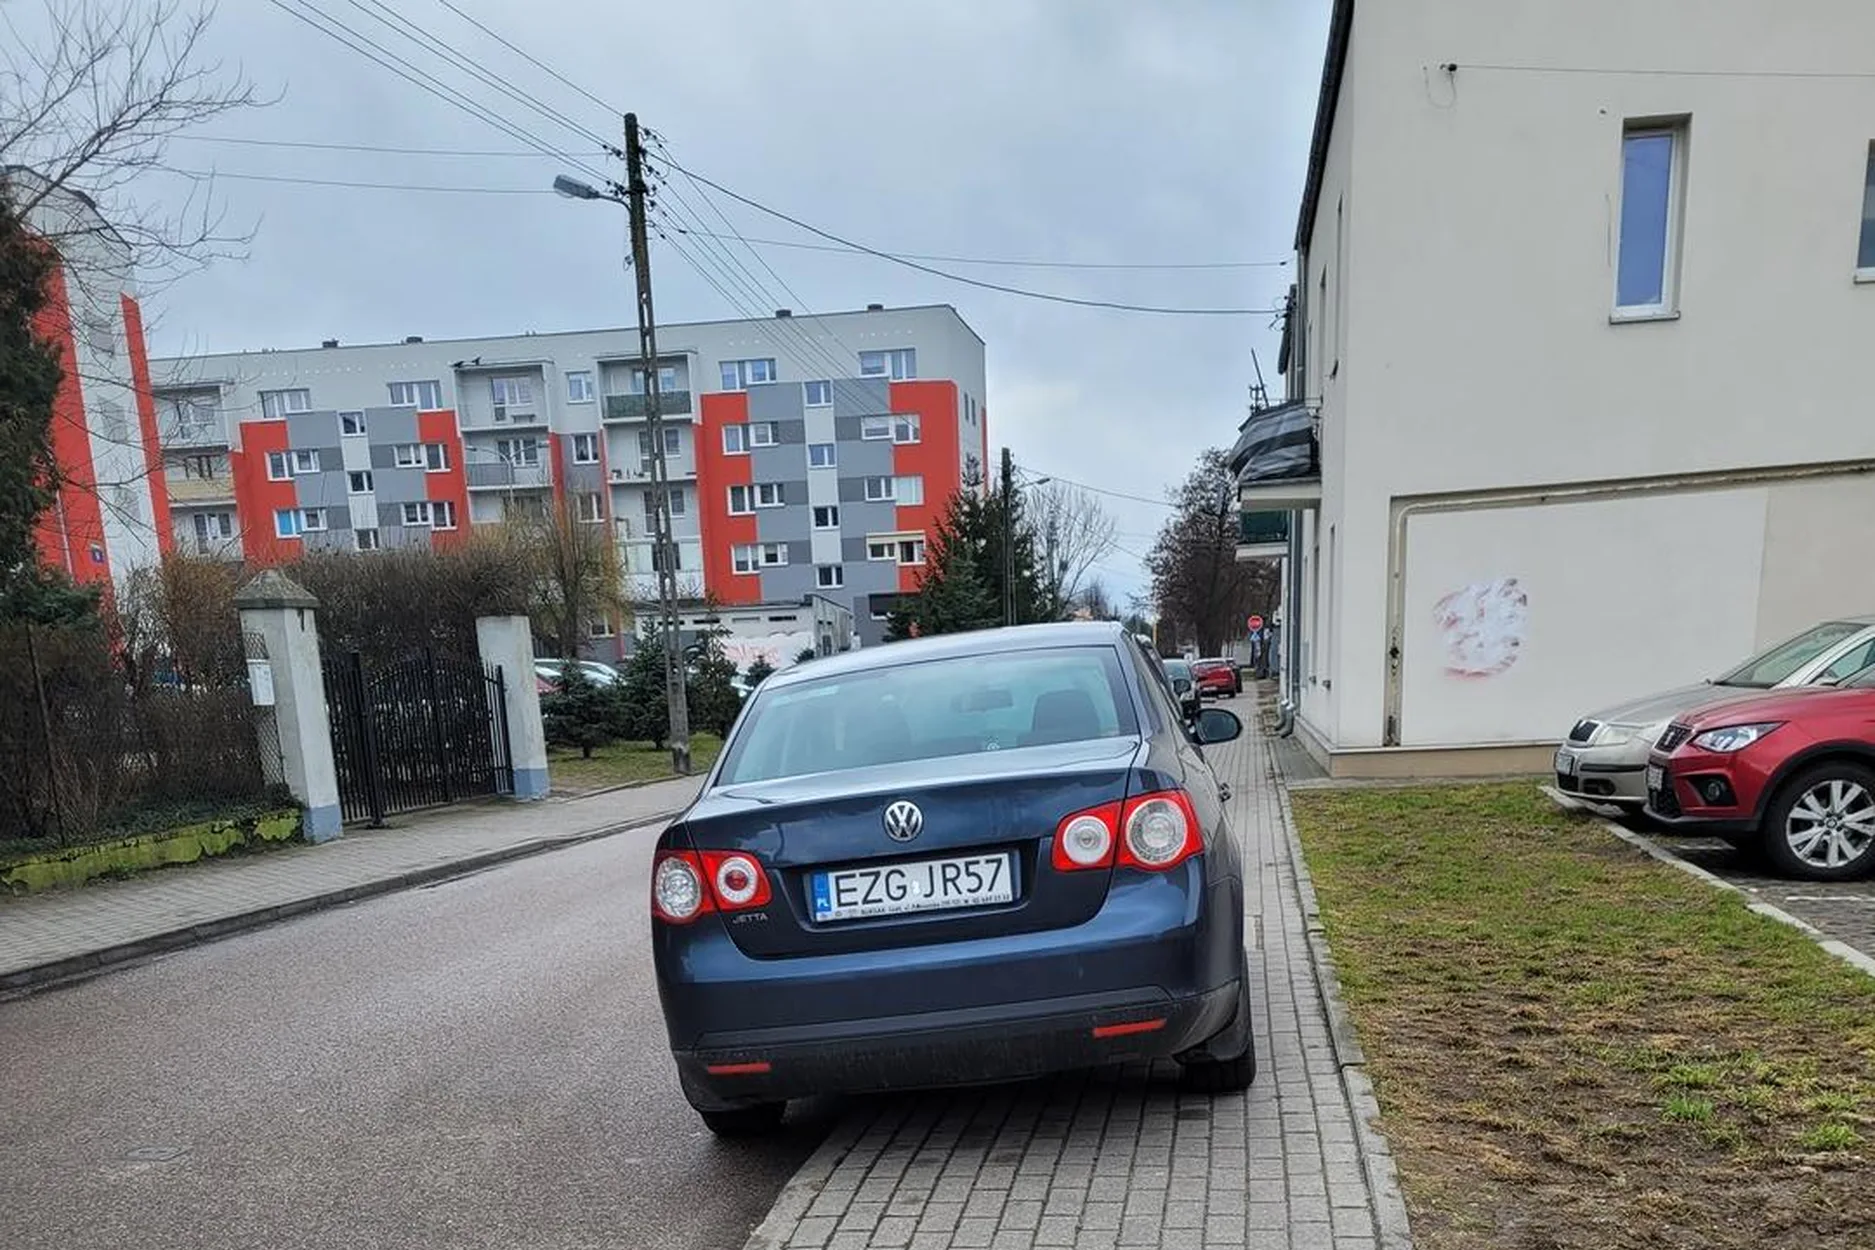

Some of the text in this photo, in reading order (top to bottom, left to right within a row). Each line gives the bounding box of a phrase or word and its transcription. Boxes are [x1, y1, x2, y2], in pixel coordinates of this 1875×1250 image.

[835, 869, 907, 908] EZG
[923, 857, 1002, 898] JR57
[732, 912, 769, 924] JETTA
